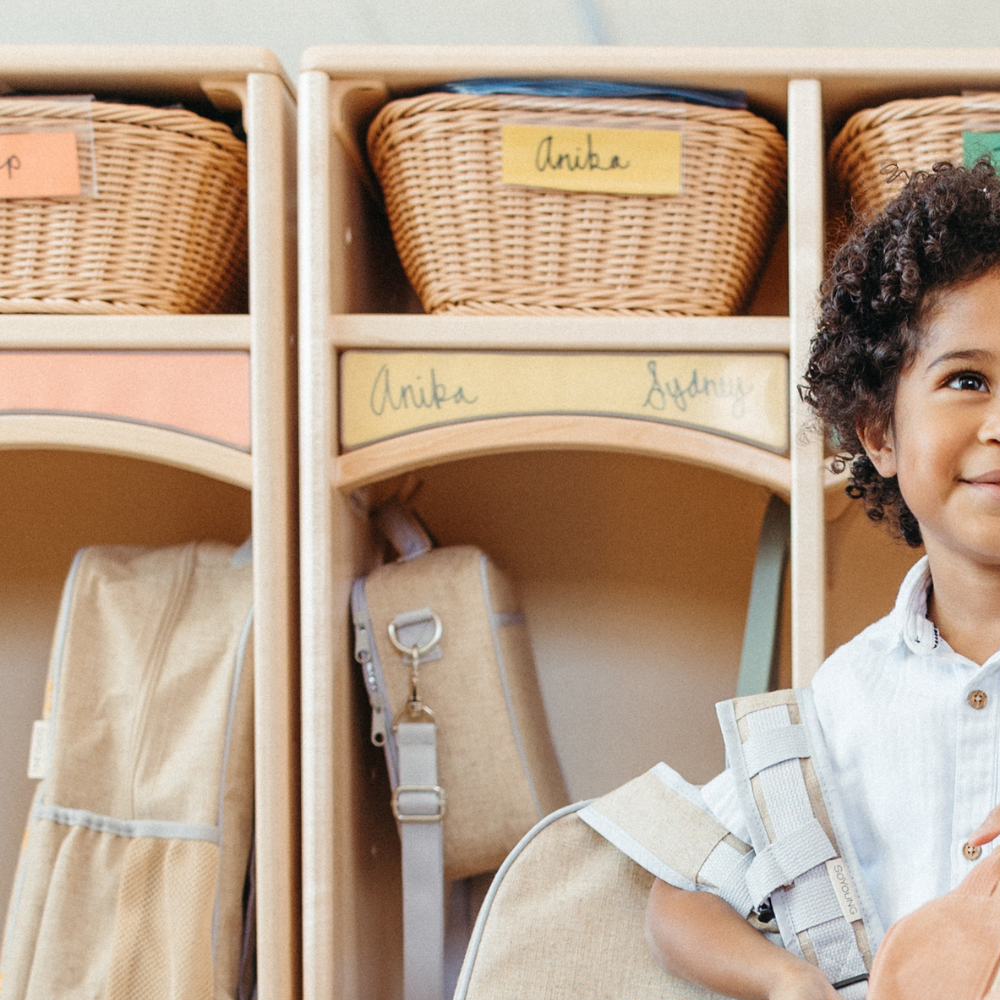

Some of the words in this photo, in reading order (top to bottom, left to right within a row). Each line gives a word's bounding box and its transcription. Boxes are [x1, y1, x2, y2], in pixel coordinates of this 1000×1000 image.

[536, 133, 629, 171] Anika
[370, 364, 478, 416] Anika
[643, 360, 754, 420] Sydney
